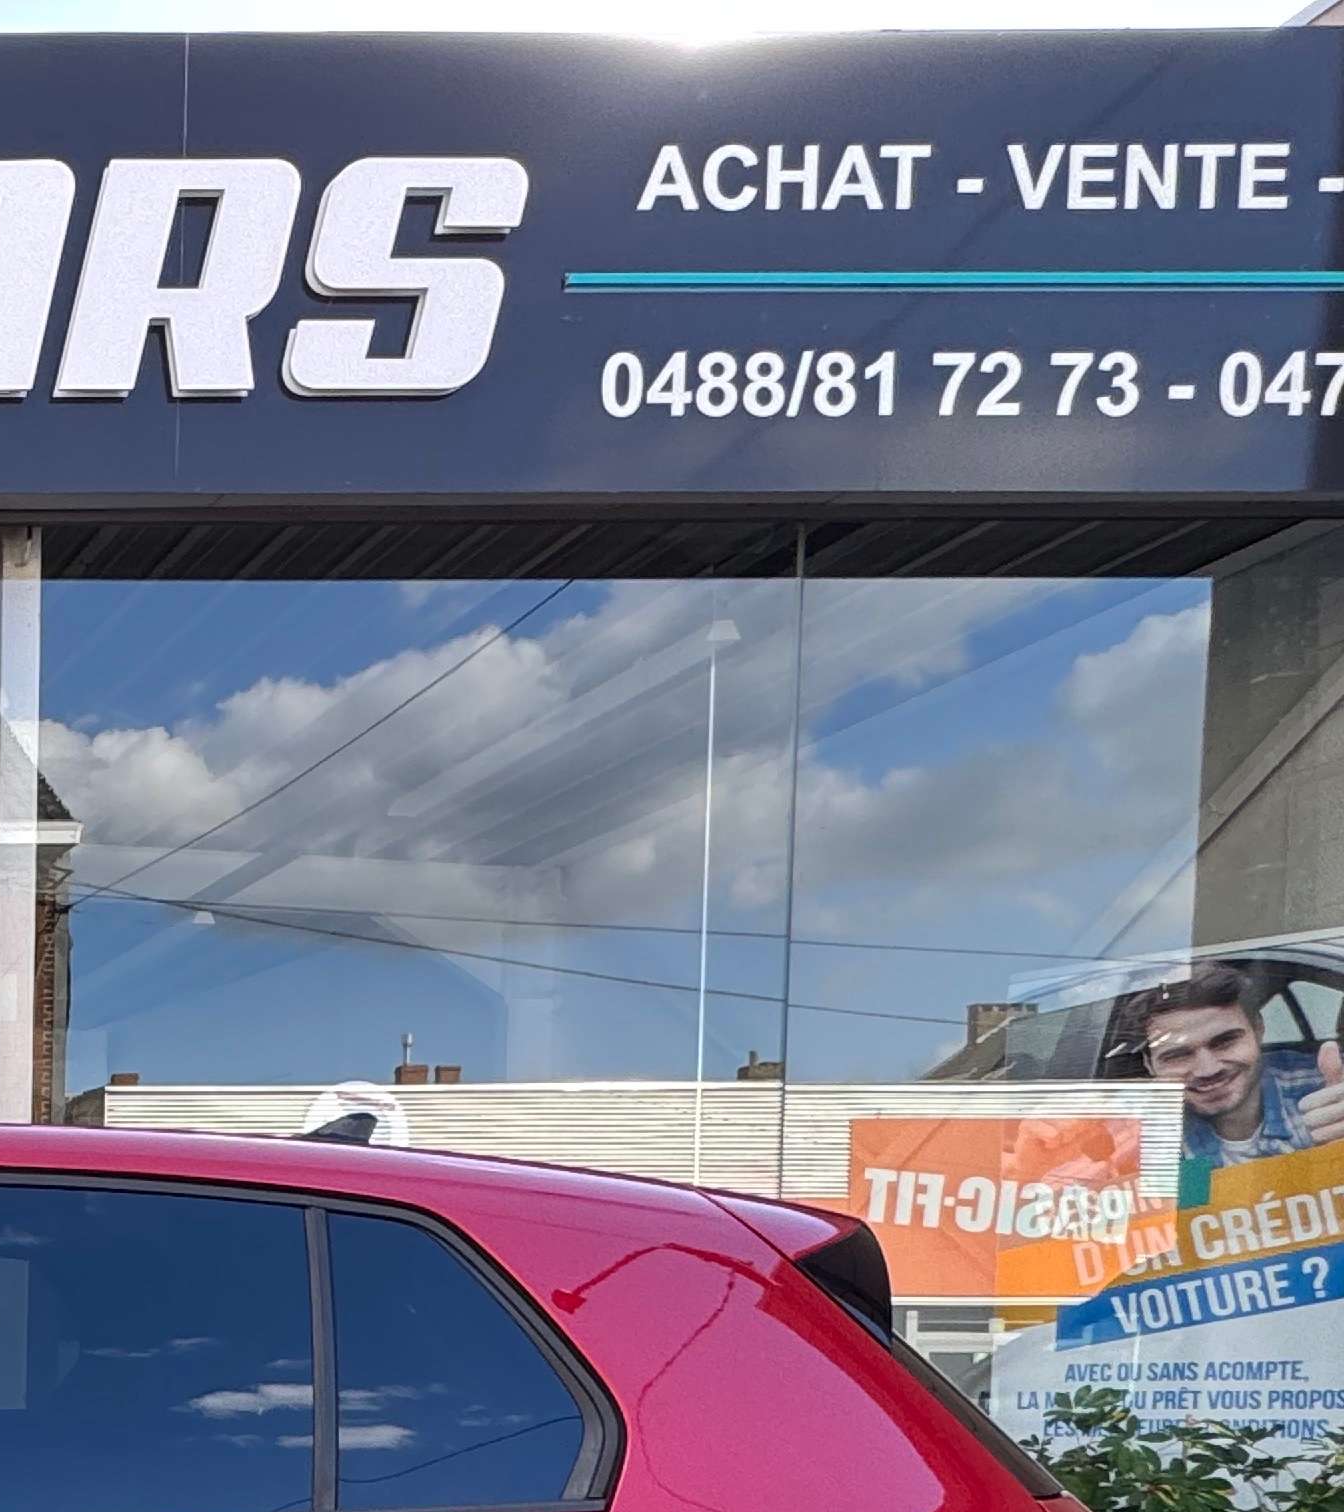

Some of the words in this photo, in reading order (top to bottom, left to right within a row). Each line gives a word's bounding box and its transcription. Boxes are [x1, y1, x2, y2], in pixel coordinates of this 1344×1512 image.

[636, 143, 932, 211] ACHAT
[1006, 142, 1292, 210] VENTE
[601, 349, 897, 418] 0488/81
[931, 350, 1022, 417] 72
[1049, 350, 1140, 417] 73
[1218, 350, 1344, 418] 047
[1110, 1262, 1296, 1334] VOITURE
[1302, 1256, 1330, 1298] ?
[1017, 1391, 1040, 1409] LA
[1151, 1386, 1202, 1409] PRÊT
[1206, 1390, 1262, 1409] VOUS
[1064, 1362, 1112, 1382] AVEC
[1117, 1362, 1142, 1382] OU
[1146, 1361, 1199, 1382] SANS
[1204, 1360, 1309, 1383] ACOMPTE,
